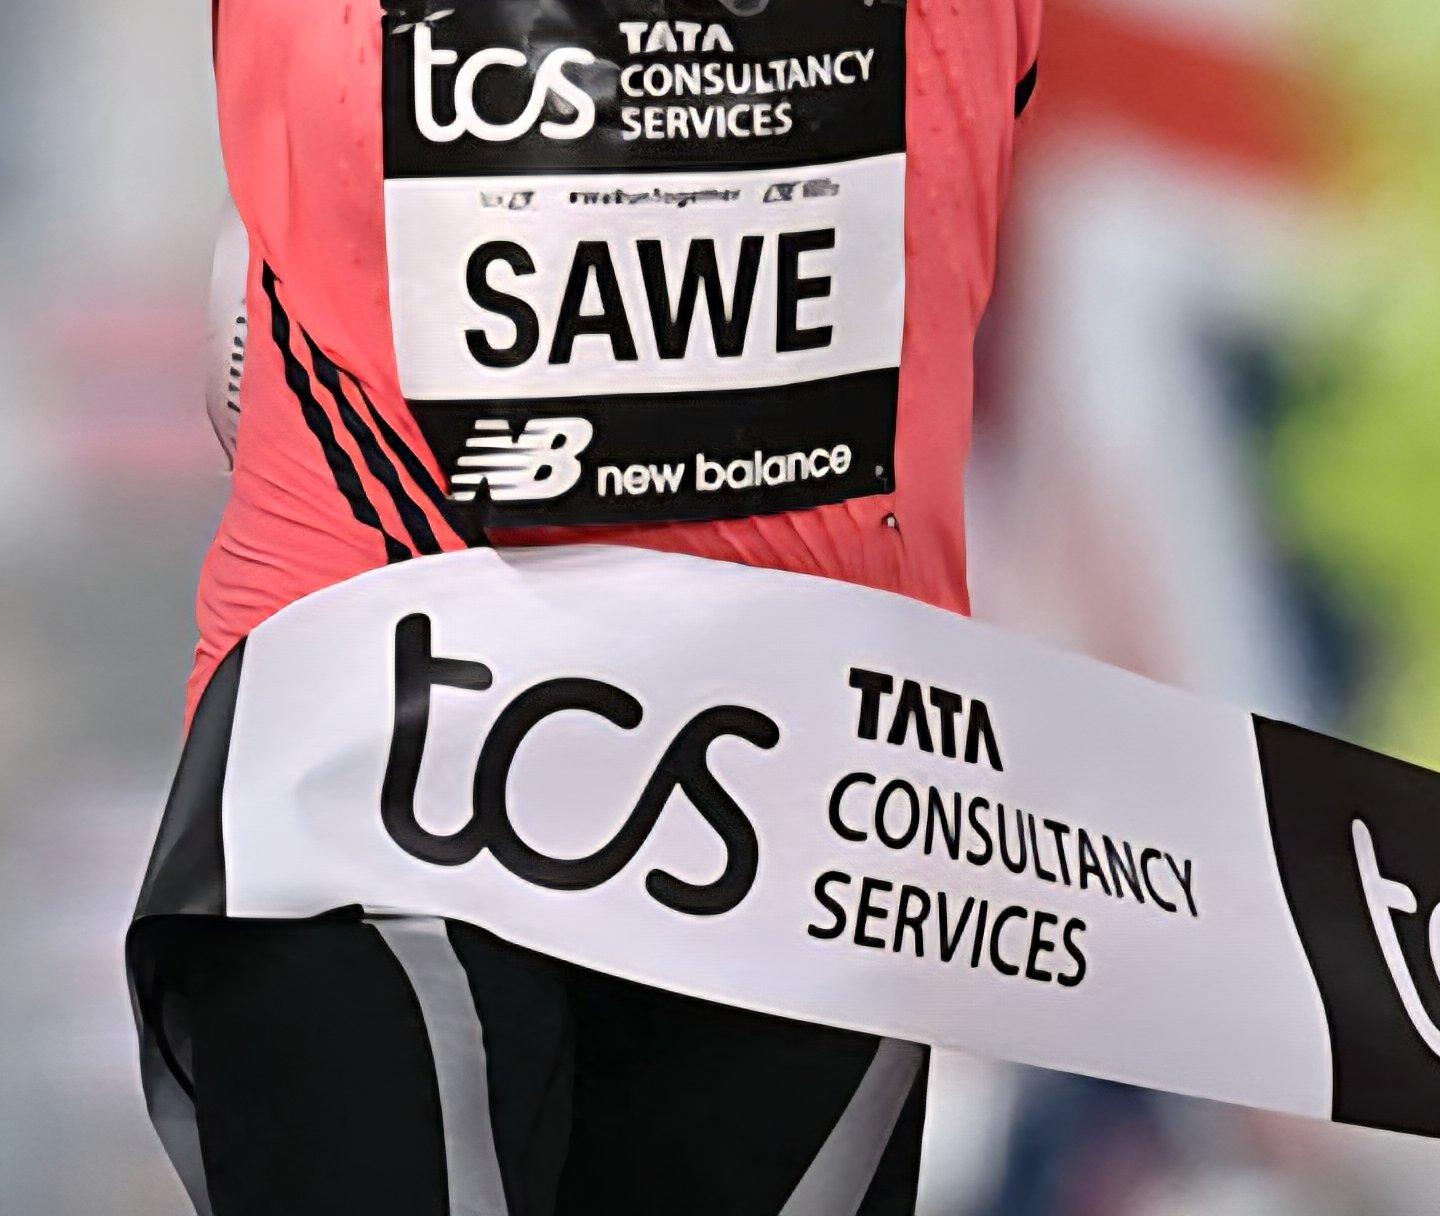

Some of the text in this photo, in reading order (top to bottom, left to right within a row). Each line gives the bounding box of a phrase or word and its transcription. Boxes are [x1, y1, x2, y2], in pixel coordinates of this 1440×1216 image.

[412, 23, 597, 143] tcs
[619, 20, 734, 53] TATA
[619, 48, 875, 98] CONSULTANCY
[621, 102, 793, 141] SERVICES
[464, 227, 837, 369] SAWE
[597, 443, 853, 497] new balance
[380, 612, 780, 916] tcs
[848, 667, 1004, 772] TATA
[828, 772, 1198, 918] CONSULTANCY
[807, 870, 1087, 987] SERVICES
